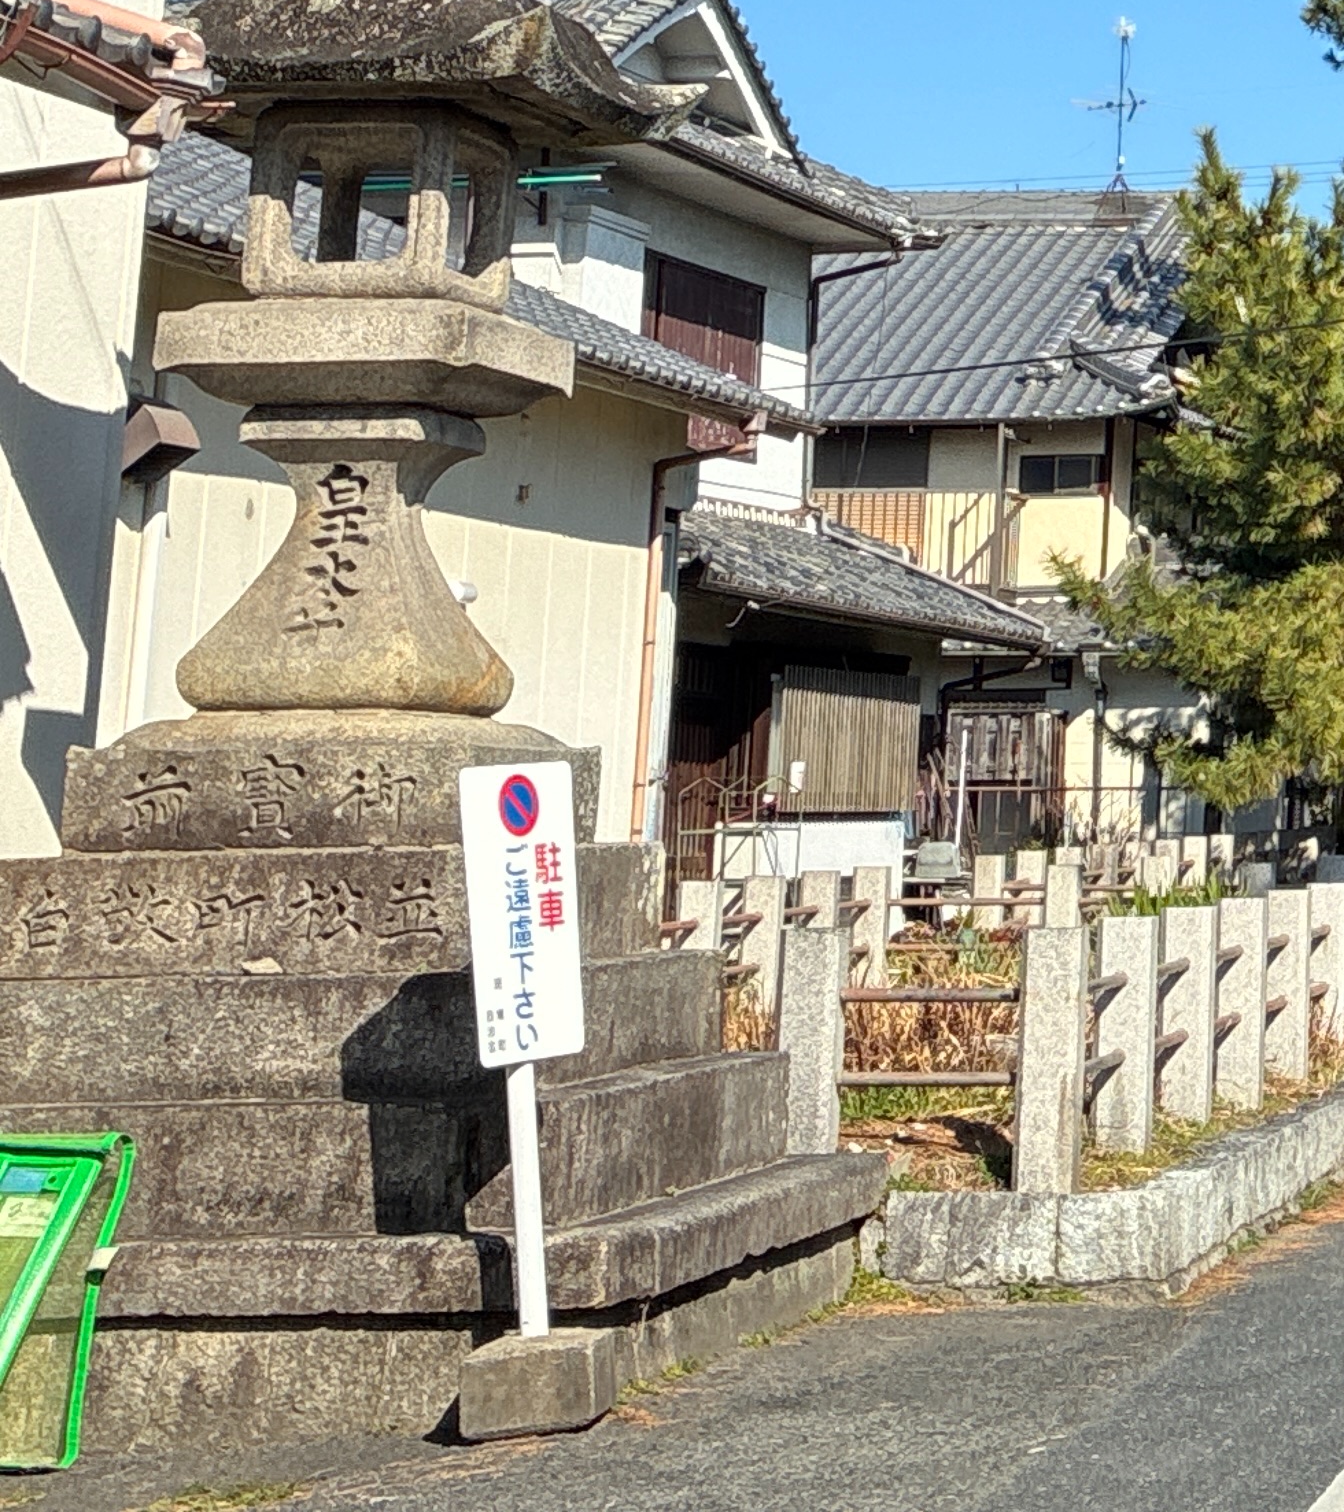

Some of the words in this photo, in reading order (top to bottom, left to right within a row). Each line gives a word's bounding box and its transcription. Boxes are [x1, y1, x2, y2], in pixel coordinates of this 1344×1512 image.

[505, 843, 538, 1051] ご遠慮下さい
[535, 842, 565, 931] 駐車
